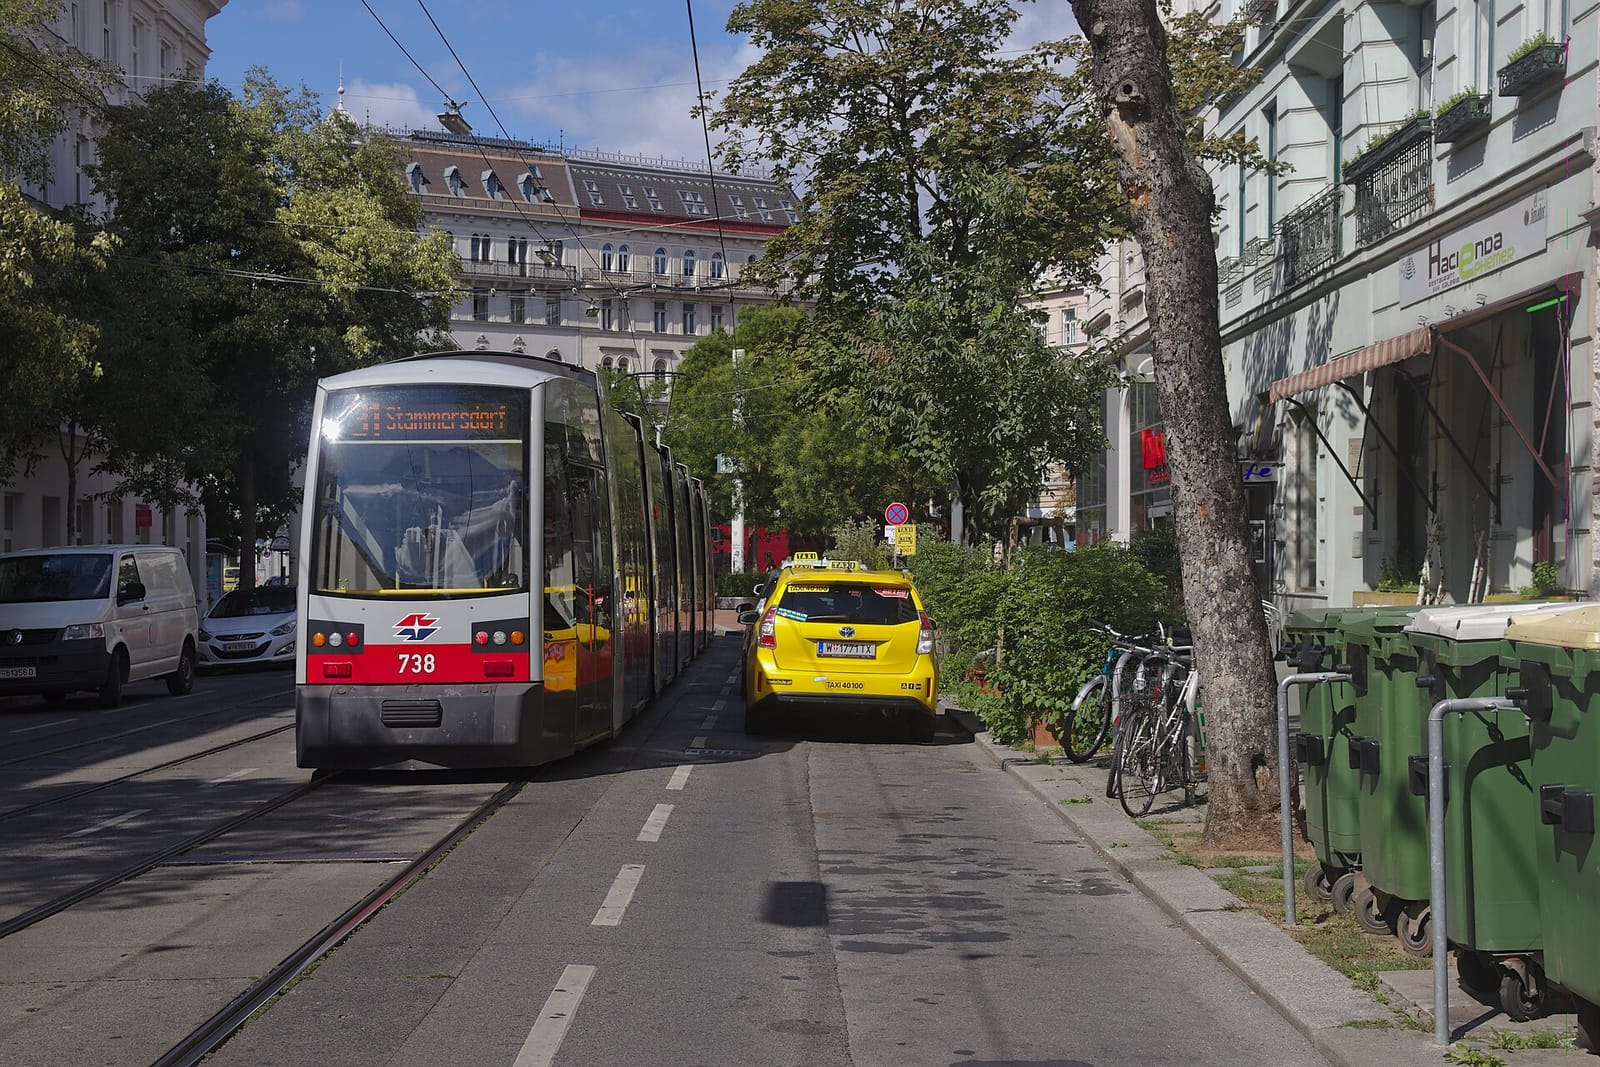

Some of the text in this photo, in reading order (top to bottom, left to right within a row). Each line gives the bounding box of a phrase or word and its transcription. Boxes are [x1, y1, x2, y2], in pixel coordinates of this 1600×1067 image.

[386, 405, 505, 430] Stammersdorf
[831, 561, 856, 569] TAXI
[826, 642, 833, 652] W
[399, 653, 435, 673] 738
[827, 681, 864, 690] TAXI 40100
